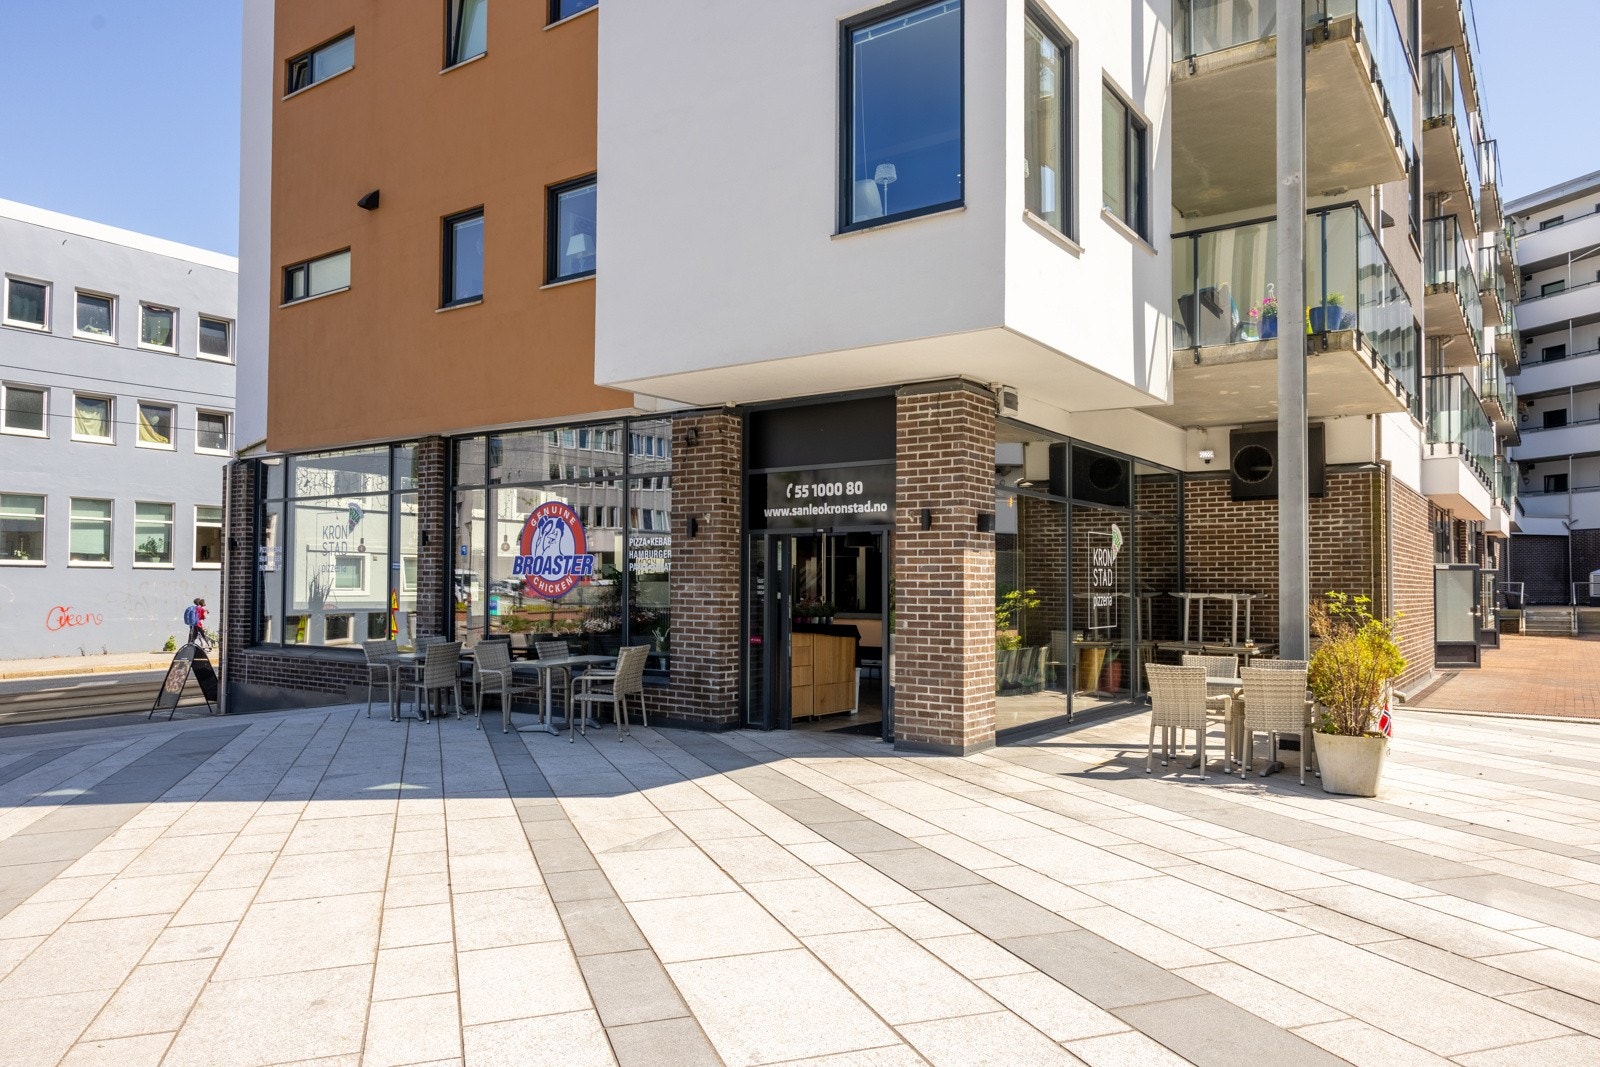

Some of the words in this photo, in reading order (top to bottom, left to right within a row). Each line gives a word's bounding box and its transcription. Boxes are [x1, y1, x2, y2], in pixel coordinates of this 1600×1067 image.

[794, 484, 809, 498] 55
[812, 482, 843, 497] 1000
[846, 481, 864, 495] 80
[531, 506, 576, 527] GENUINE
[764, 500, 888, 517] www.sanleokronstad.no
[322, 525, 348, 540] KRON
[322, 541, 348, 556] STAD
[629, 549, 672, 559] HAMBURGER
[1093, 548, 1113, 566] KRON
[512, 554, 595, 576] BROASTER
[533, 575, 573, 594] CHICKEN
[1093, 568, 1113, 586] STAD
